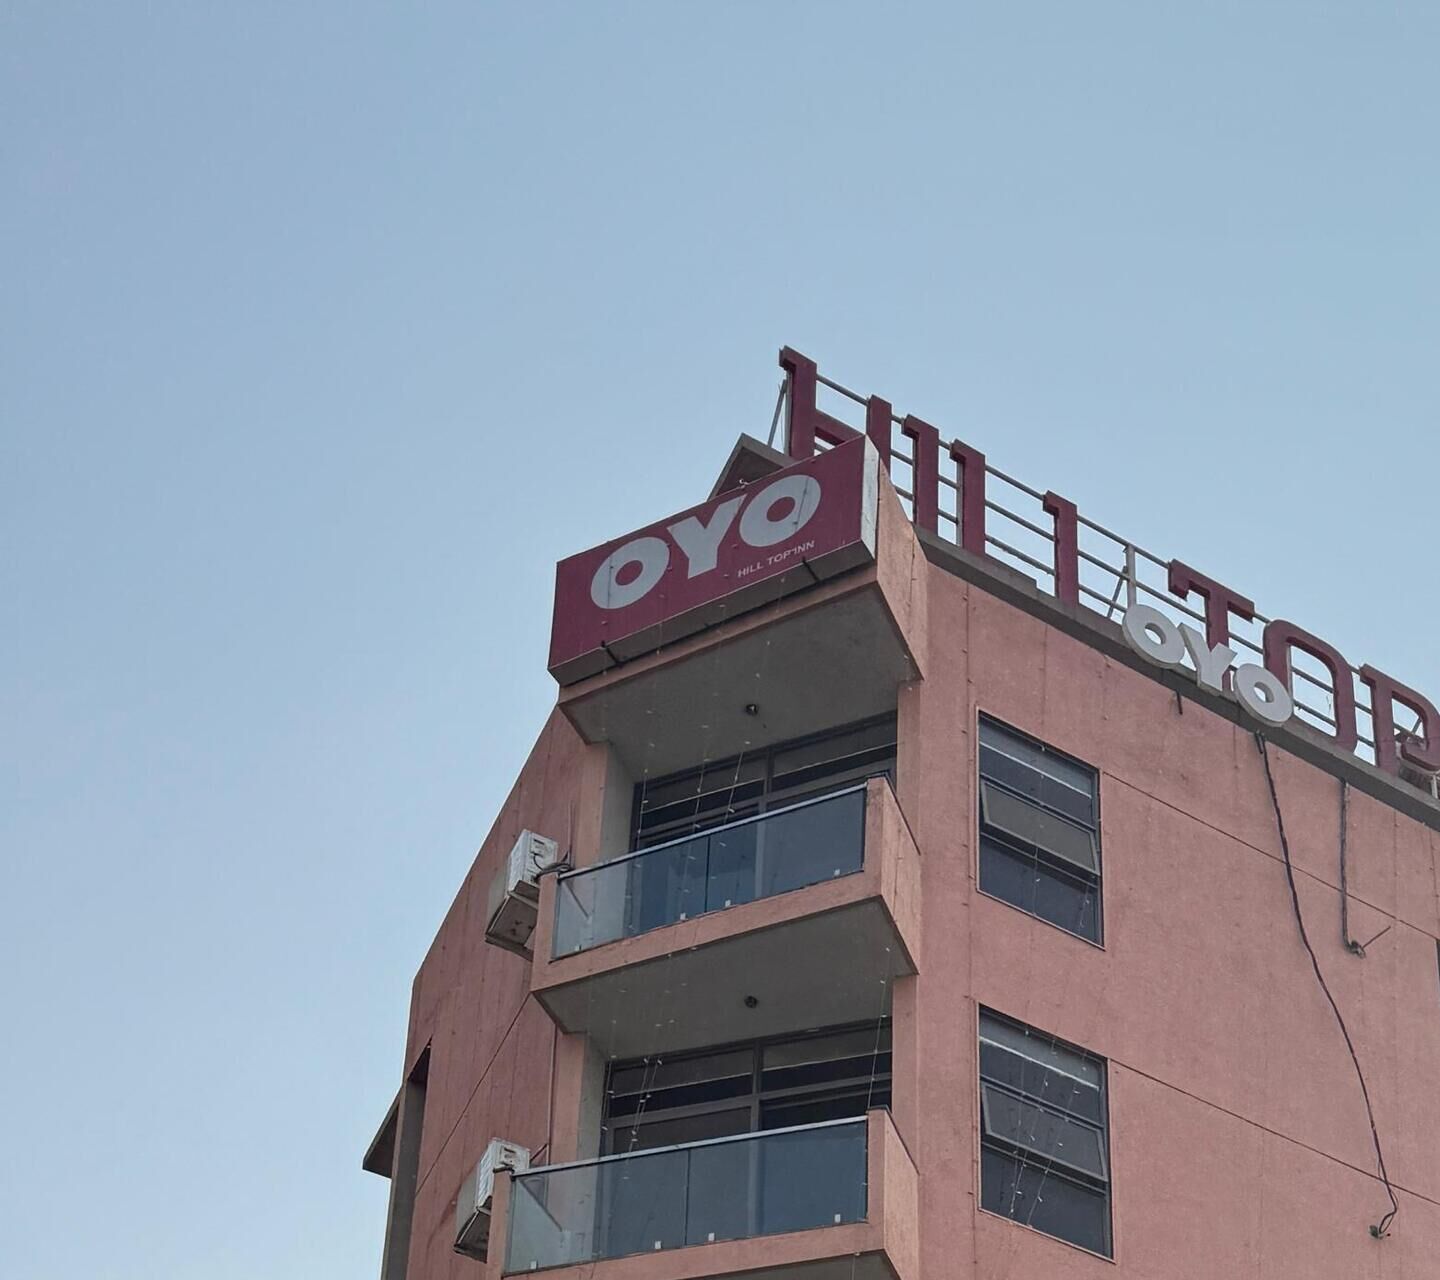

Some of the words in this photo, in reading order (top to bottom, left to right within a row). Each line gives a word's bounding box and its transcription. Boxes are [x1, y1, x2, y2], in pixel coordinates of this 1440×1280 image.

[591, 474, 822, 610] OYO
[737, 561, 764, 578] HILL
[766, 550, 792, 566] TOP
[792, 540, 815, 556] INN
[1122, 603, 1294, 727] OYO
